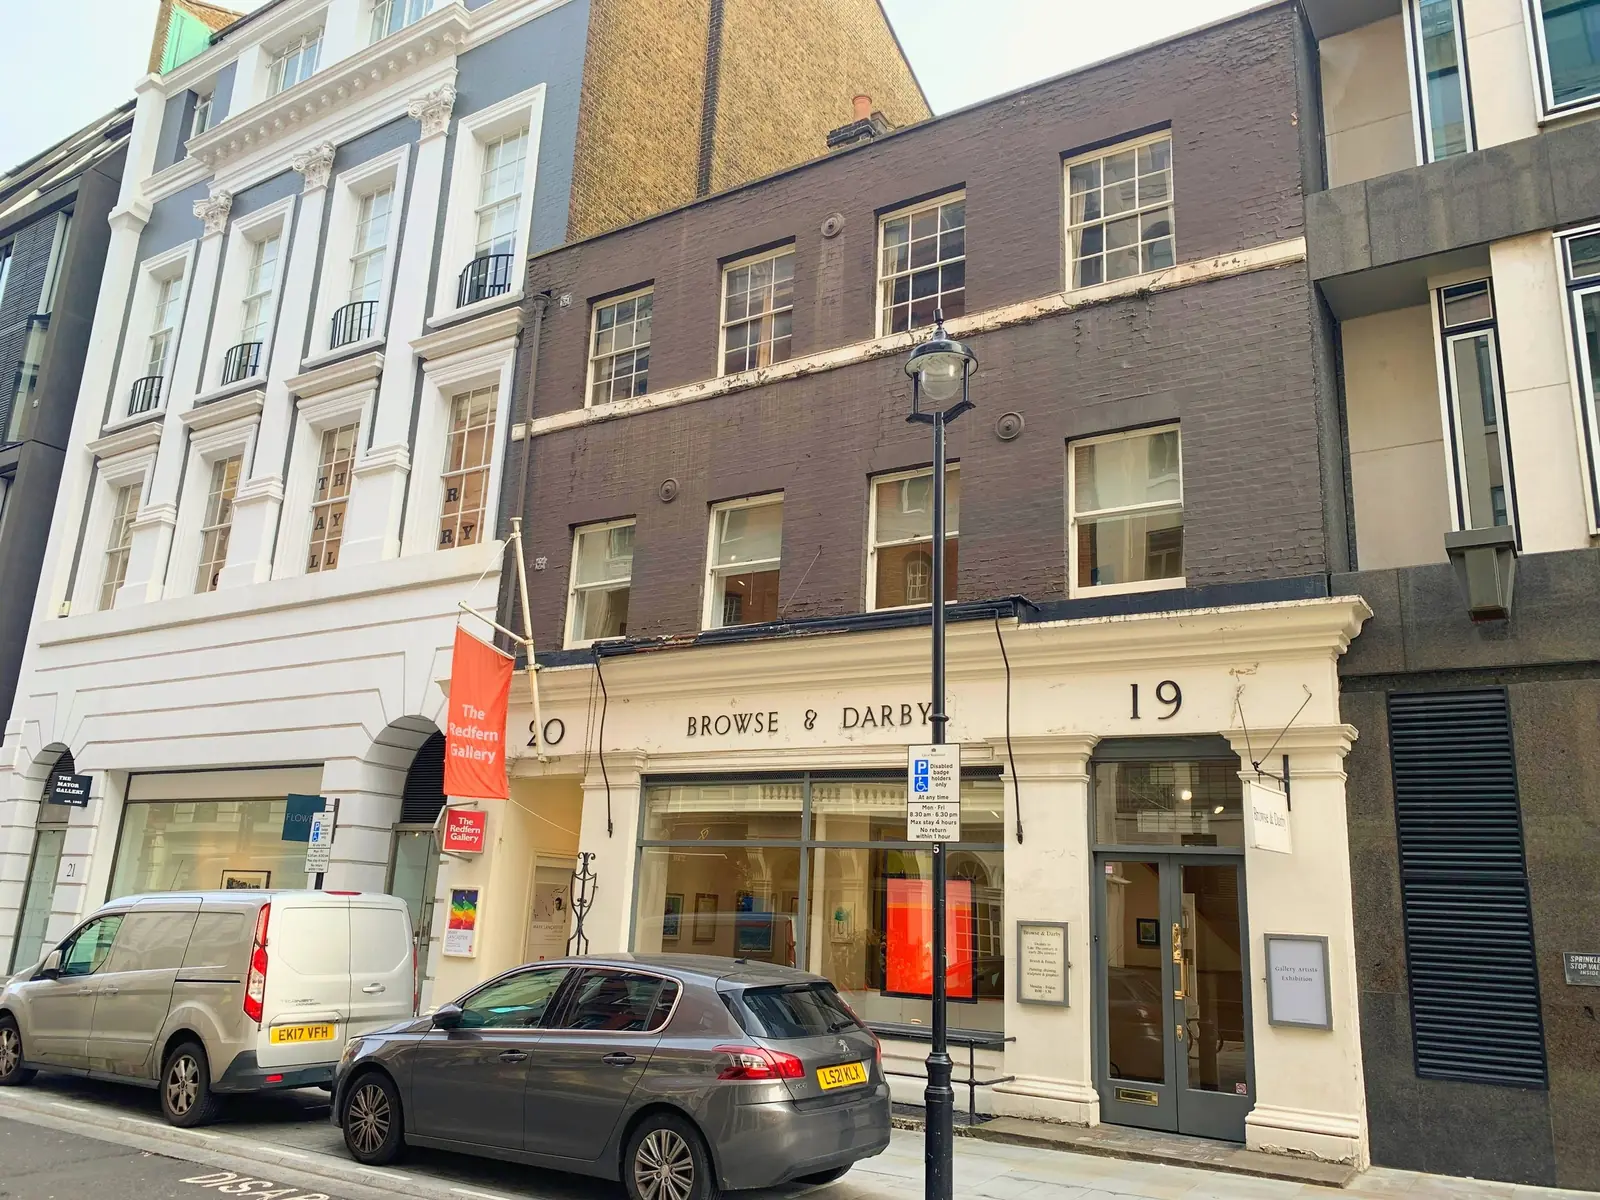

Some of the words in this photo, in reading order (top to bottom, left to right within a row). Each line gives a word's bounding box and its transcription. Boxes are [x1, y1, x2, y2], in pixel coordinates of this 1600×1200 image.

[445, 488, 459, 502] R
[1130, 680, 1182, 719] 19
[462, 704, 486, 720] The
[687, 711, 779, 736] BROWSE
[804, 709, 817, 730] &
[842, 702, 933, 730] DARBY
[449, 722, 499, 742] Redfern
[450, 743, 496, 765] Gallery
[917, 761, 927, 774] P
[458, 817, 474, 826] The
[450, 825, 480, 834] Redfern
[450, 833, 479, 843] Gallery
[933, 844, 940, 853] 5
[66, 863, 76, 877] 21
[278, 1027, 304, 1041] EK17
[307, 1026, 328, 1039] VFH
[822, 1067, 844, 1085] LS21
[843, 1065, 861, 1081] KLX
